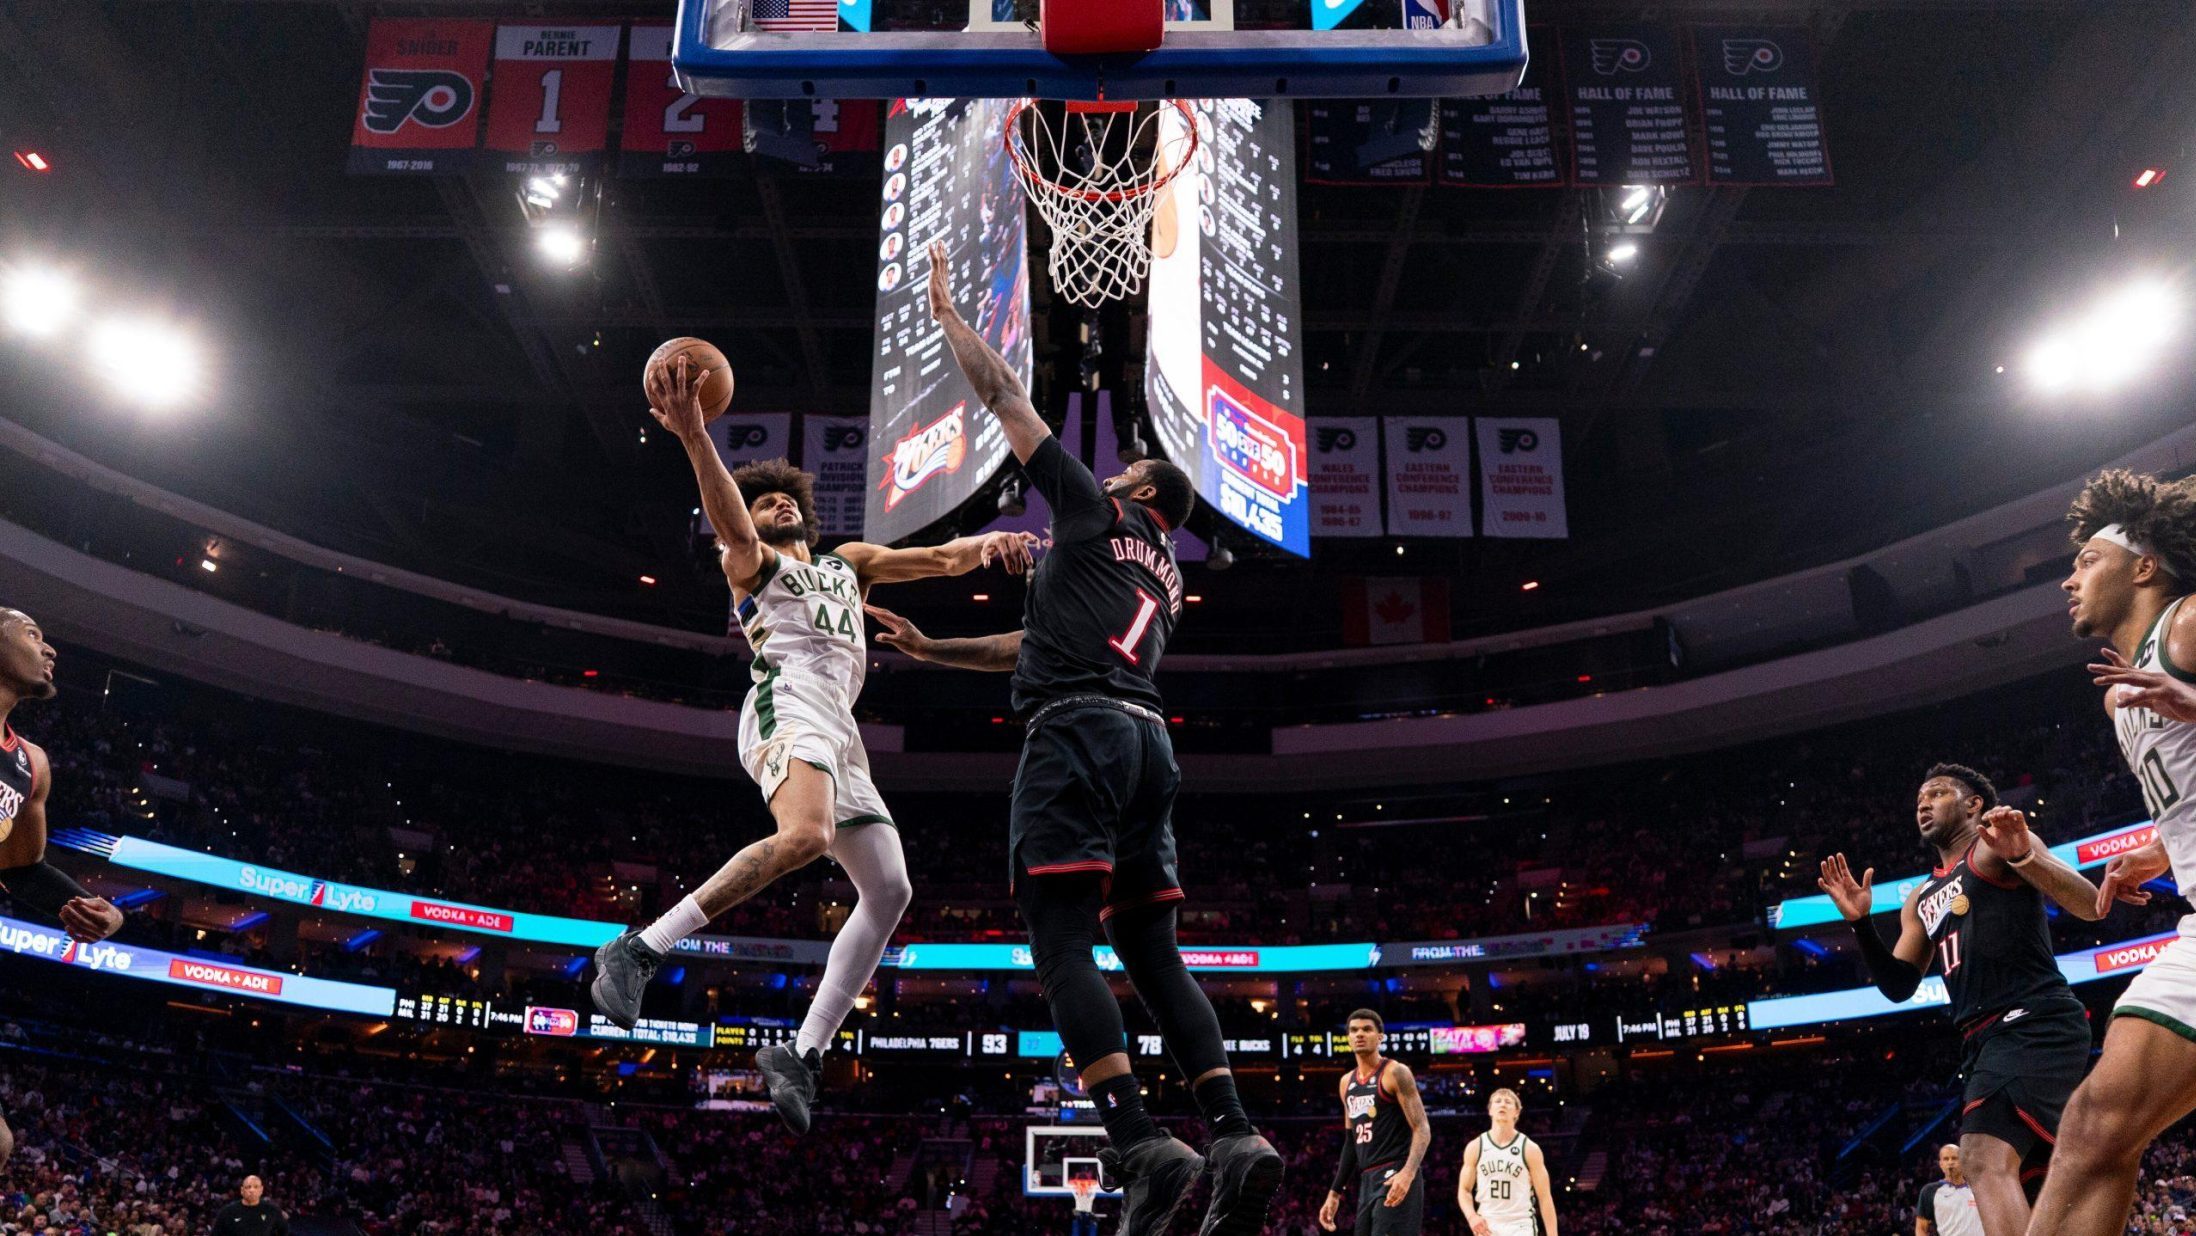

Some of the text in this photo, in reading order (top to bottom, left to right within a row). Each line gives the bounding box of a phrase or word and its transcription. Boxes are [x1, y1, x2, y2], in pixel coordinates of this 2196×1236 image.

[1411, 15, 1434, 30] NBA
[541, 31, 577, 43] BERNIE
[524, 42, 592, 56] PARENT
[1505, 87, 1542, 101] FAME
[1578, 86, 1674, 100] HALL OF FAME
[1710, 86, 1808, 100] HALL OF FAME
[535, 69, 563, 133] 1
[664, 74, 706, 132] 2
[821, 462, 864, 471] PATRICK
[1405, 463, 1450, 473] EASTERN
[1498, 464, 1543, 474] EASTERN
[820, 472, 864, 482] DIVISION
[1396, 473, 1459, 484] CONFERENCE
[1489, 474, 1553, 485] CONFERENCE
[1398, 484, 1459, 494] CHAMPIONS
[1493, 485, 1553, 495] CHAMPIONS
[1110, 536, 1182, 615] DRUMMOND
[780, 568, 858, 608] BUCKS
[813, 603, 857, 645] 44
[1109, 587, 1160, 665] 1
[2090, 834, 2138, 857] VODKA
[239, 867, 376, 912] Super Lyte
[1917, 875, 1963, 931] SIXERS
[424, 905, 467, 923] VODKA
[478, 912, 501, 928] ADE
[703, 940, 730, 954] THE
[1939, 930, 1962, 977] 11
[77, 942, 131, 970] Lyte
[2108, 944, 2162, 966] VODKA
[184, 963, 231, 985] VODKA
[242, 973, 269, 991] ADE
[400, 998, 415, 1009] PHI
[421, 1003, 433, 1011] 37
[398, 1008, 479, 1026] MIL 31 20 2 6
[509, 1013, 523, 1024] PM
[1665, 1019, 1680, 1029] PHI
[1685, 1017, 1696, 1027] 37
[590, 1024, 630, 1038] CURRENT
[632, 1027, 661, 1041] TOTAL:
[716, 1026, 745, 1037] PLAYER
[764, 1029, 769, 1037] 1
[1553, 1023, 1590, 1042] JULY 19
[1623, 1022, 1657, 1034] 7:46 PM
[1665, 1021, 1745, 1038] MIL 31 20 2 6
[716, 1035, 744, 1045] POINTS
[843, 1041, 851, 1051] 4
[870, 1037, 960, 1049] PHILADELPHIA 76ERS
[982, 1034, 1007, 1054] 93
[1137, 1034, 1162, 1055] 78
[1239, 1039, 1271, 1051] BUCKS
[1405, 1042, 1413, 1051] 6
[1294, 1044, 1321, 1055] 4 4
[1356, 1122, 1373, 1145] 25
[1480, 1159, 1522, 1177] BUCKS
[1491, 1181, 1511, 1200] 20
